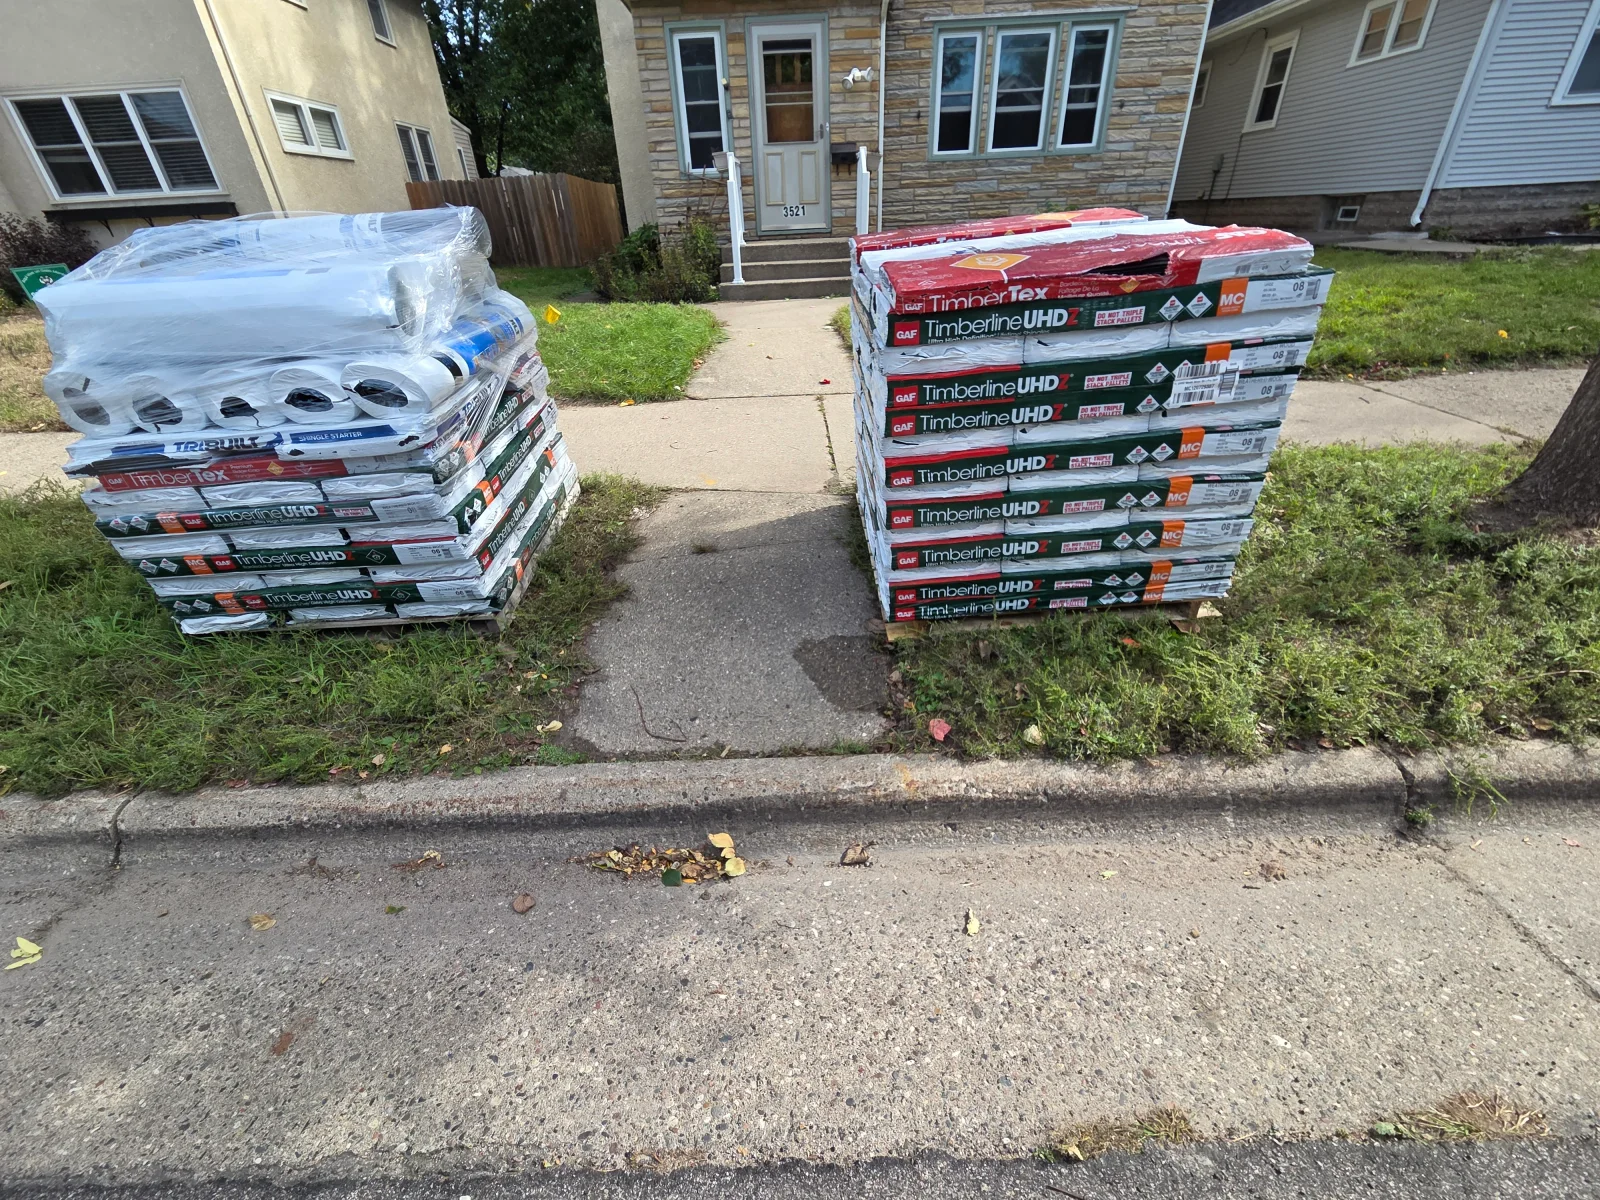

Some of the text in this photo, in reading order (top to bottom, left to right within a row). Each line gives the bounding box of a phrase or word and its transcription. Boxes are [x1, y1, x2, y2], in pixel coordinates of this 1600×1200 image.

[783, 205, 806, 218] 3521
[1292, 281, 1304, 292] 08
[904, 284, 1050, 312] GAF TimberTex
[1220, 292, 1244, 306] MC
[1117, 316, 1142, 324] PALLETS
[896, 330, 918, 340] GAF
[1272, 350, 1284, 360] 08
[1261, 386, 1272, 395] 08
[896, 393, 916, 402] GAF
[893, 422, 914, 432] GAF
[299, 431, 362, 442] SHINGLE STARTER
[172, 436, 260, 452] TRIBUILT
[1180, 442, 1201, 452] MC
[1242, 438, 1252, 446] 08
[125, 468, 230, 487] TimberTex
[892, 476, 912, 486] GAF
[1167, 492, 1188, 502] MC
[1228, 489, 1239, 498] 08
[893, 516, 912, 524] GAF
[1221, 522, 1231, 532] 08
[1162, 530, 1182, 540] MC
[899, 556, 916, 564] GAF
[1150, 572, 1168, 580] MC
